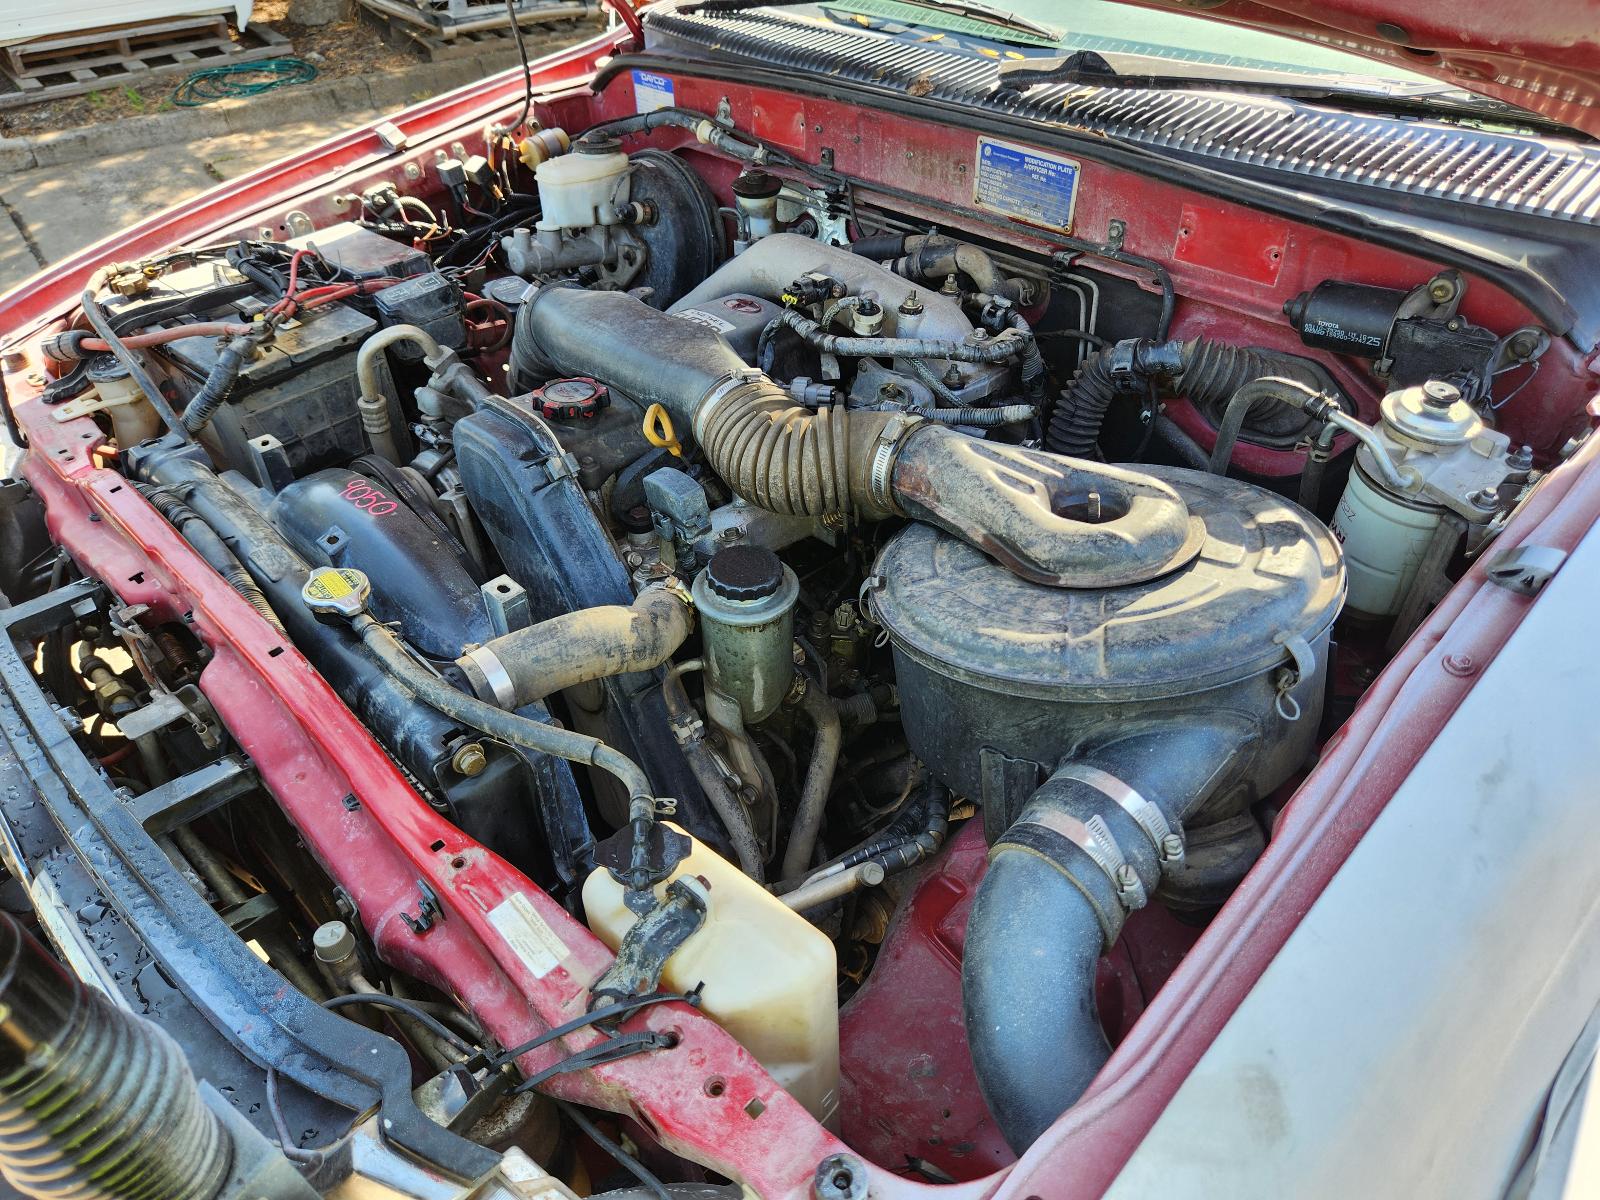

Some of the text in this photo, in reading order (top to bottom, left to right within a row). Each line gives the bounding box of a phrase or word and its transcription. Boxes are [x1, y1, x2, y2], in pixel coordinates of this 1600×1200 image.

[1024, 156, 1057, 171] MODIFICATION
[1057, 162, 1073, 175] PLATE
[1318, 320, 1339, 329] TOYOTA
[1366, 336, 1382, 347] 25
